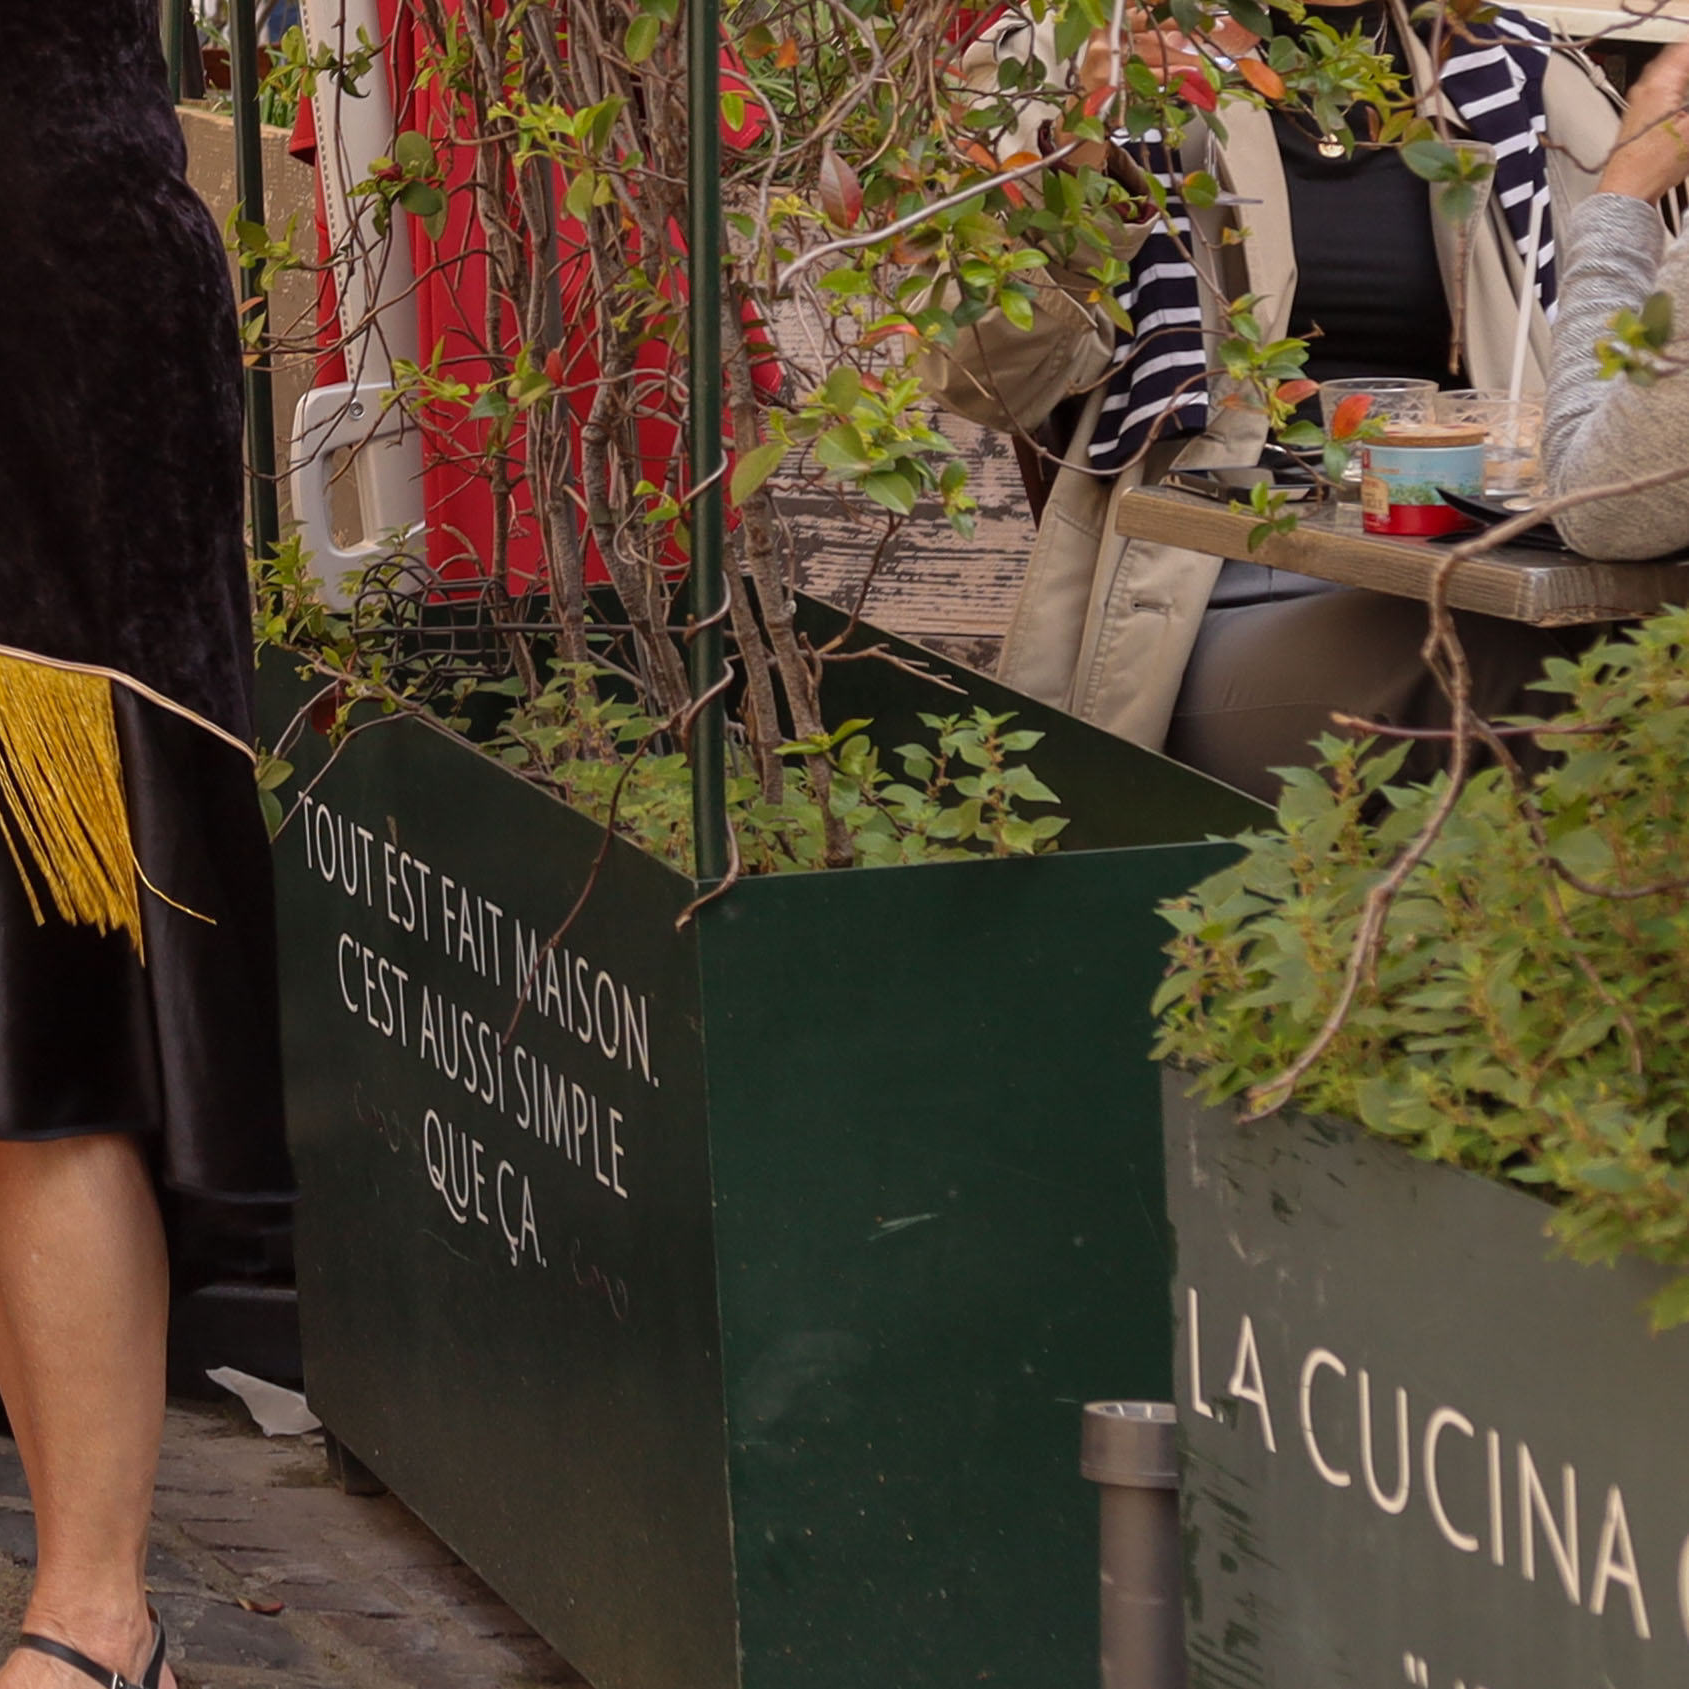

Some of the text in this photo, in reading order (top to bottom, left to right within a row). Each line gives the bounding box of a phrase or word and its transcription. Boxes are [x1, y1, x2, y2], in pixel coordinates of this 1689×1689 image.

[298, 791, 661, 1089] TOUT EST FAIT MAISON.
[338, 932, 629, 1199] C'EST AUSSI SIMPLE
[424, 1108, 549, 1268] QUE ÇA.
[1188, 1286, 1277, 1454] LA
[1299, 1346, 1653, 1640] CUCINA
